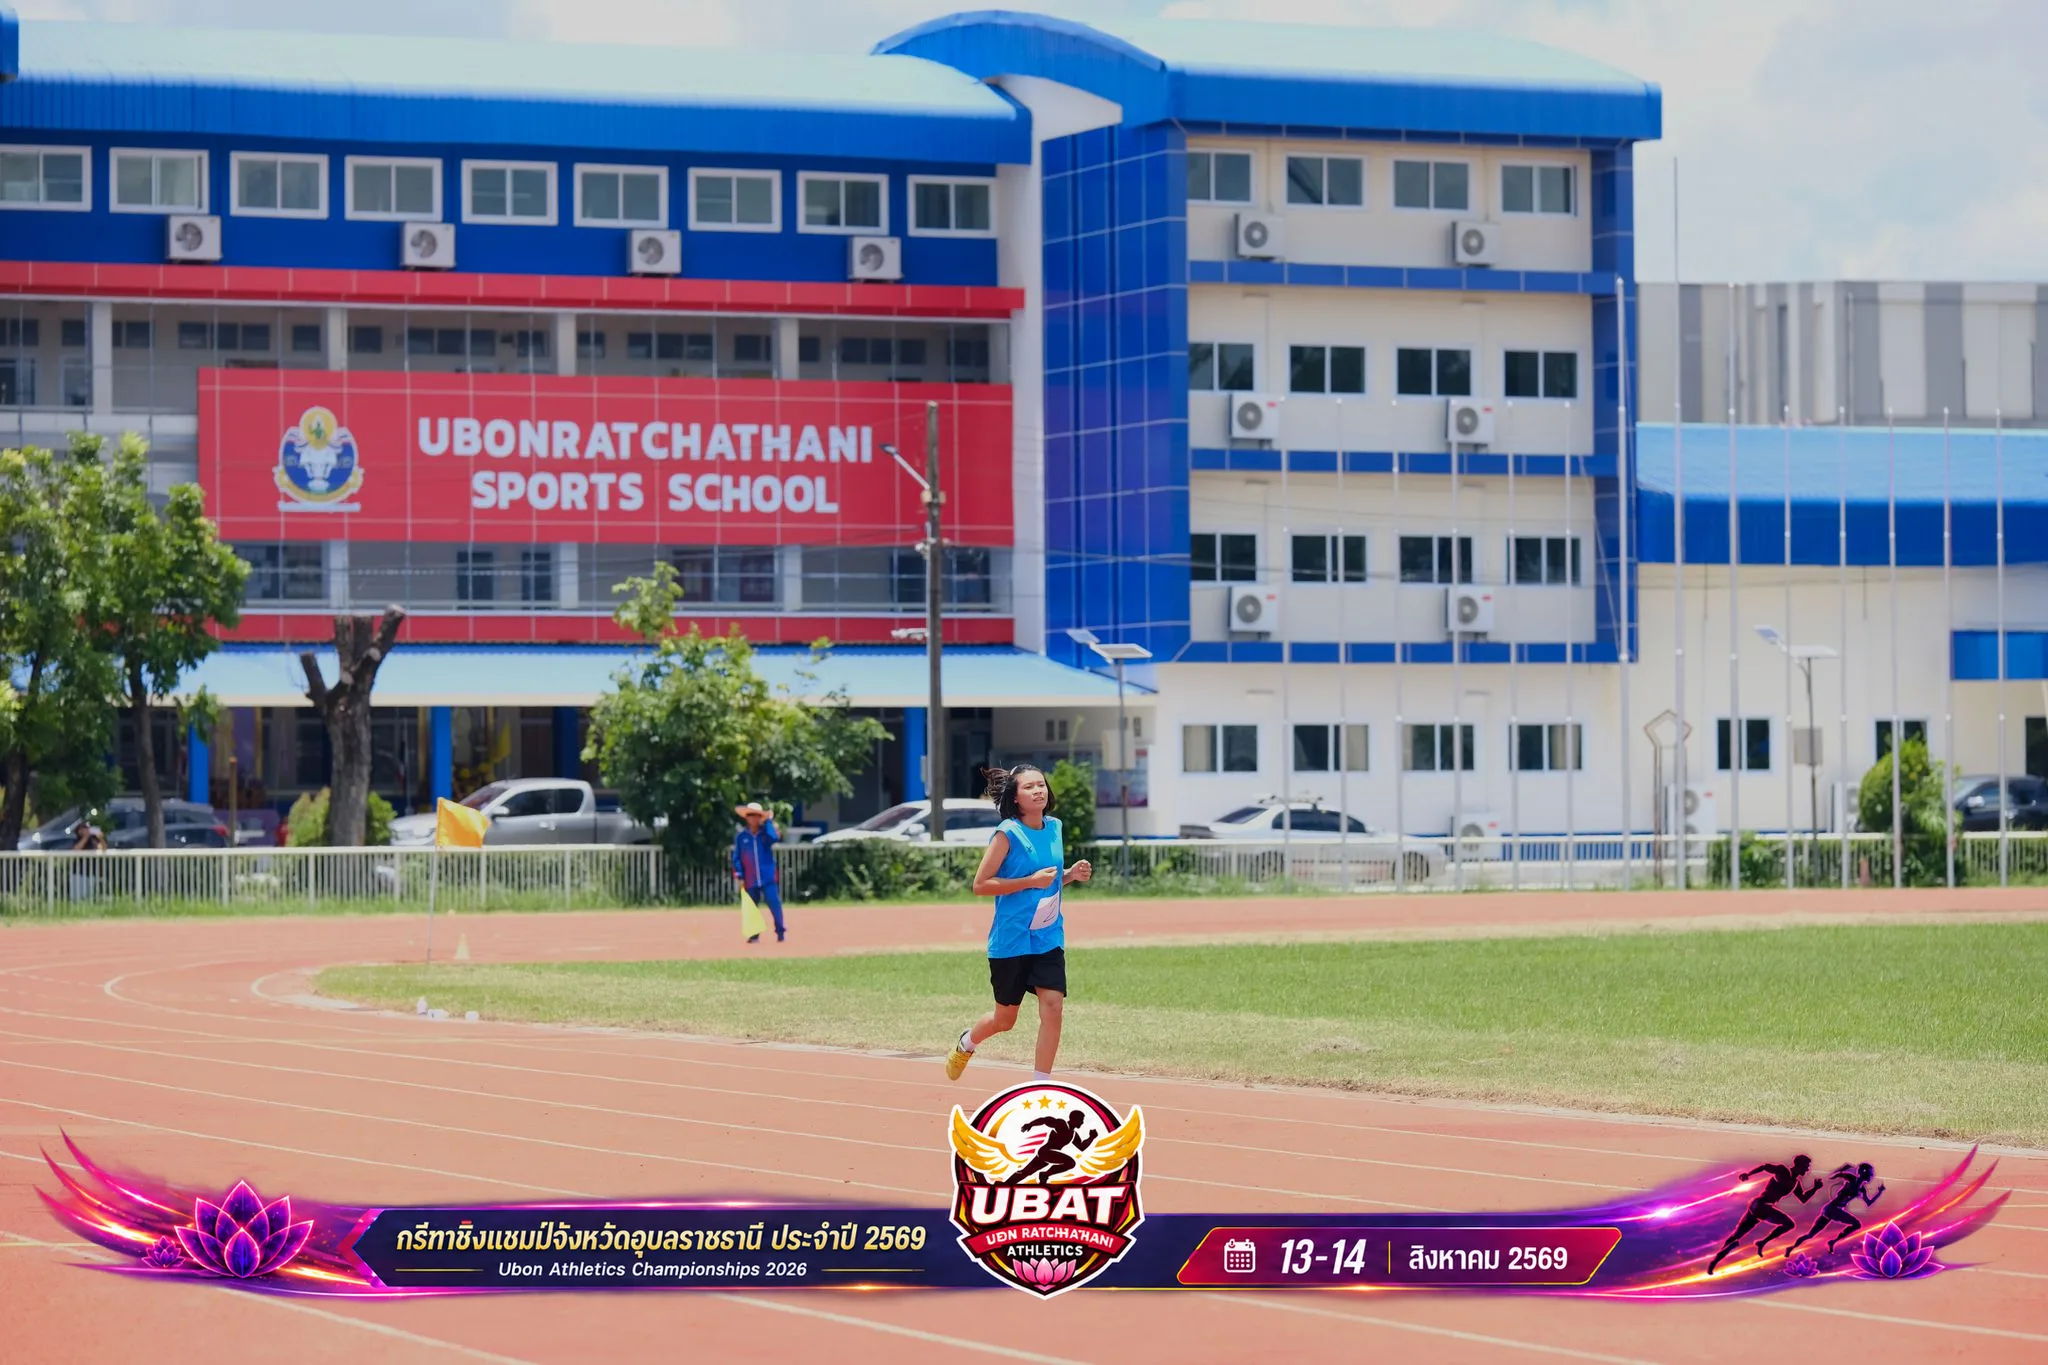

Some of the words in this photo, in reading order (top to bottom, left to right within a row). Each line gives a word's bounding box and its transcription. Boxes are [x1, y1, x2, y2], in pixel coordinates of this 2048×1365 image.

[418, 416, 872, 463] UBONRATCHATHANI
[471, 470, 645, 512] SPORTS
[668, 472, 840, 514] SCHOOL
